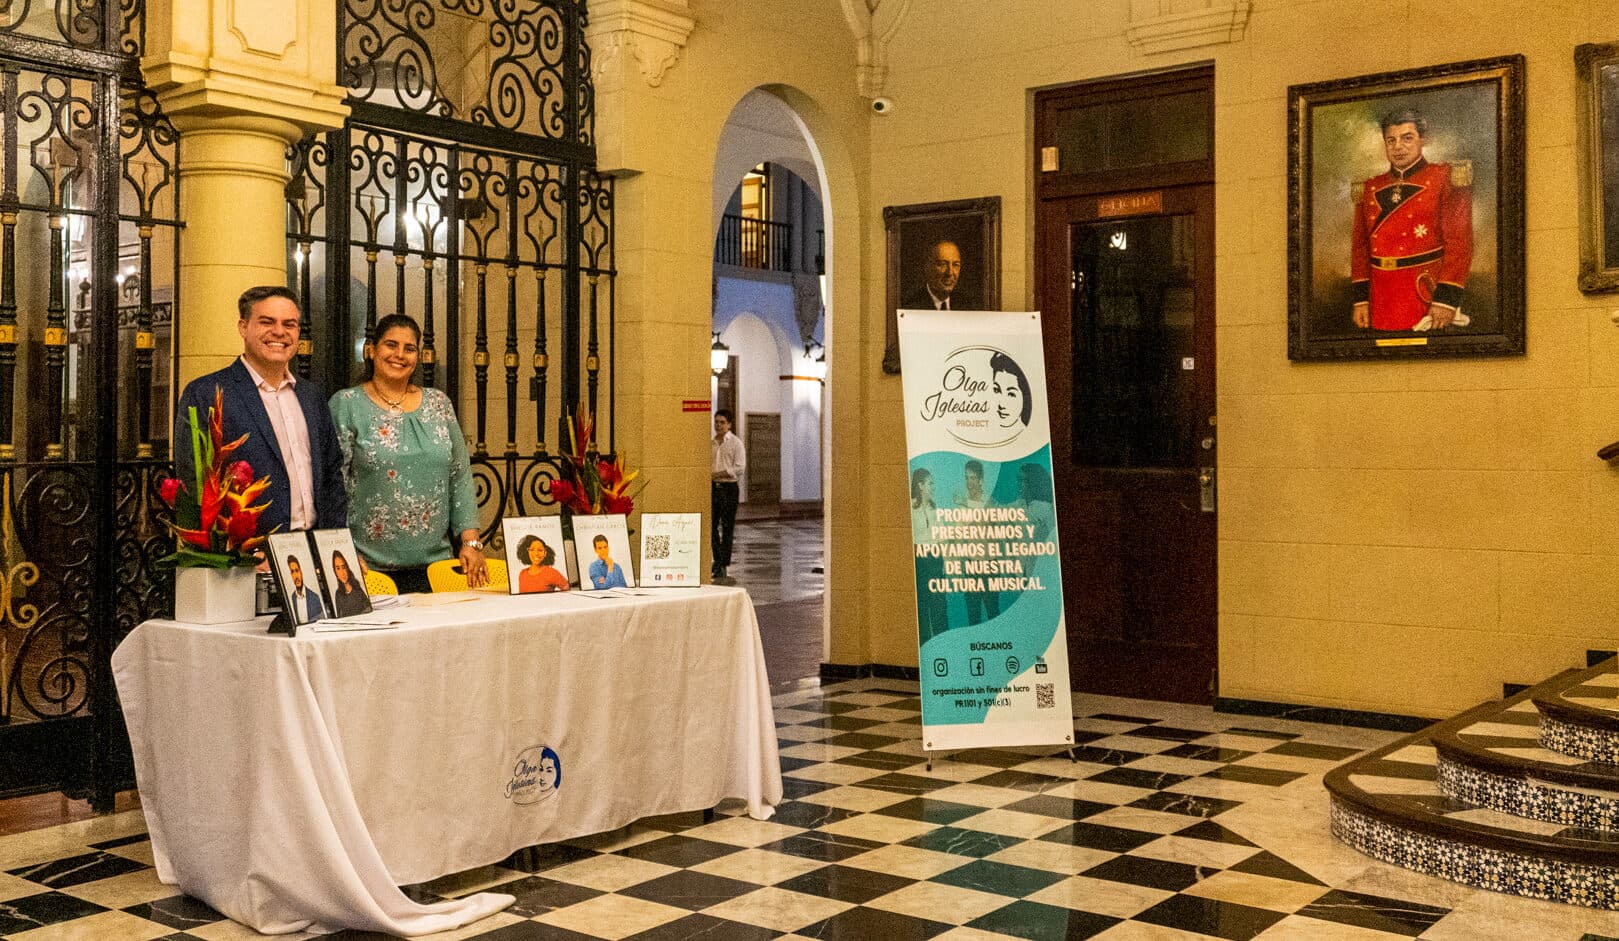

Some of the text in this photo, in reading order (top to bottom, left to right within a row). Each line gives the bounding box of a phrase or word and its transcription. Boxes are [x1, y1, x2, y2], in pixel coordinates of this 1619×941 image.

[943, 365, 988, 397] Olga
[920, 391, 989, 422] Iglesias
[956, 419, 989, 428] PROJECT
[931, 525, 1035, 540] PRESERVAMOS Y
[916, 541, 1056, 558] APOYAMOS EL LEGADO
[944, 560, 1023, 575] DE NUESTRA
[928, 578, 985, 593] CULTURA
[970, 641, 1013, 652] BÚSCANOS
[976, 686, 985, 694] sin
[986, 685, 1002, 694] fines
[1003, 685, 1012, 693] de
[1013, 684, 1030, 693] lucro
[978, 700, 983, 709] y
